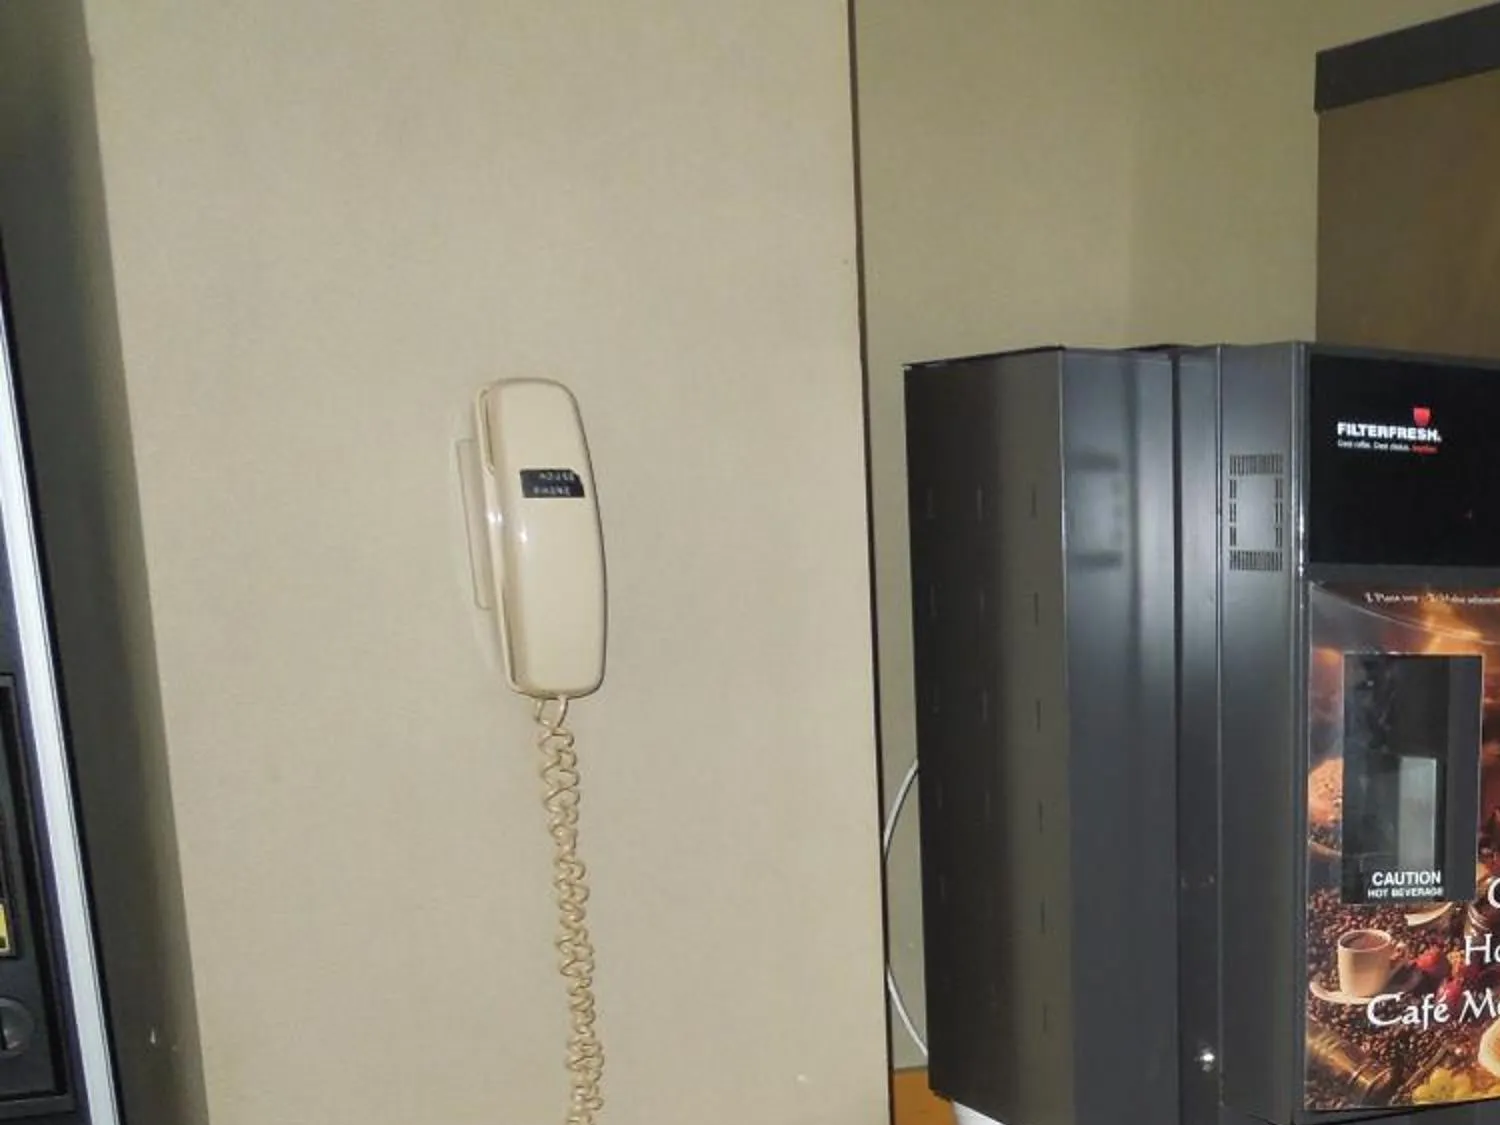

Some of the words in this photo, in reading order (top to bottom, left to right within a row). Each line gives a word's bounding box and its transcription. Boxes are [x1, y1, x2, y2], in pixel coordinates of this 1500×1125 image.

[1371, 870, 1442, 887] CAUTION
[1367, 887, 1389, 899] HOT
[1391, 886, 1444, 898] BEVERAGE
[1366, 991, 1450, 1030] Café
